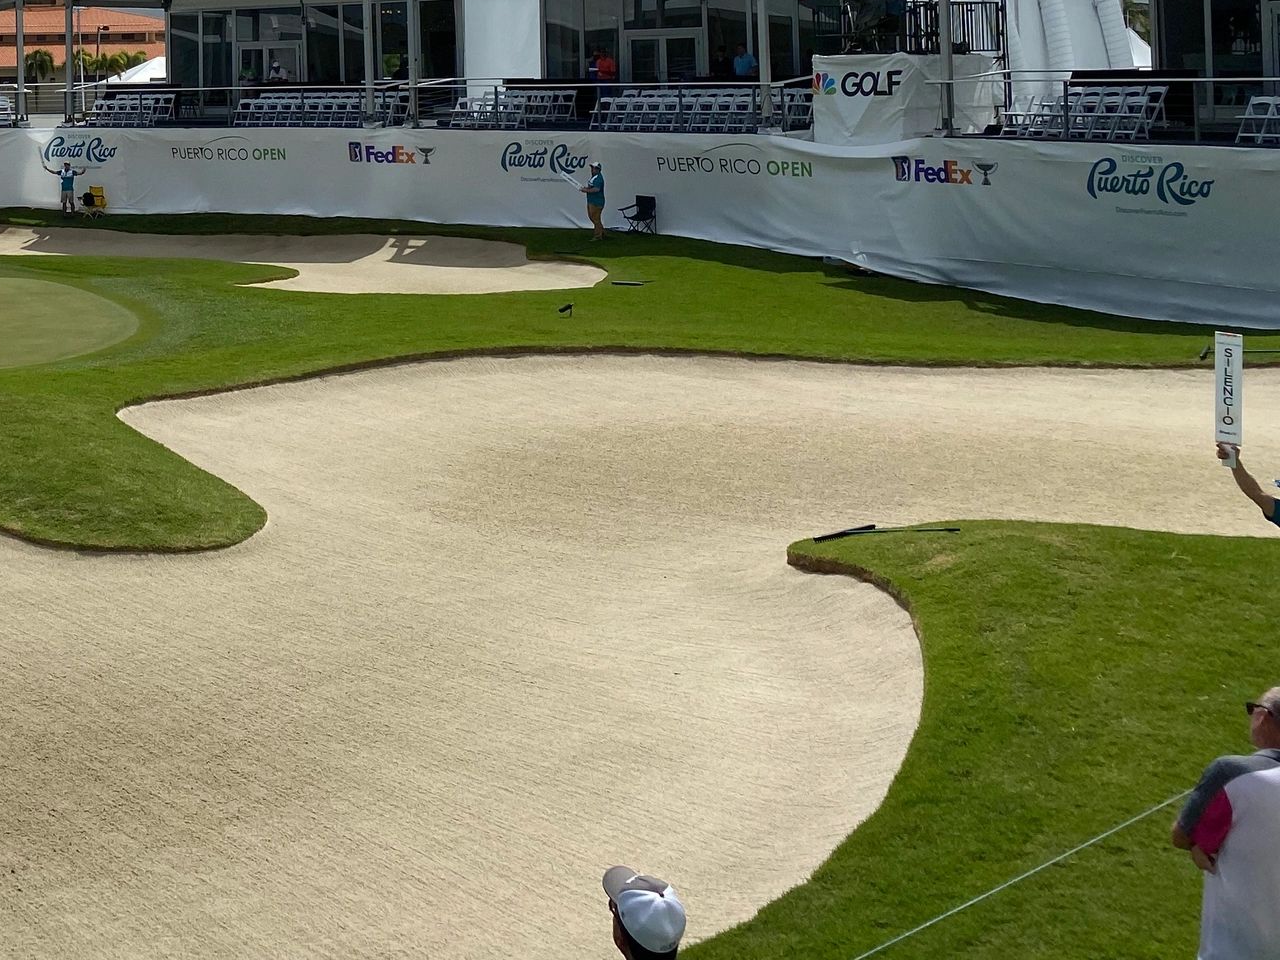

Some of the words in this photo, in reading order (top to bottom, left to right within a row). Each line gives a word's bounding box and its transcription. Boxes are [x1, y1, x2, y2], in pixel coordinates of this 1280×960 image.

[841, 70, 903, 97] GOLF
[44, 136, 86, 162] Puerto
[86, 137, 118, 162] Rico
[171, 147, 214, 160] PUERTO
[217, 148, 249, 160] RICO
[252, 148, 286, 160] OPEN
[365, 145, 416, 164] FedEx
[501, 142, 548, 172] Puerto
[550, 144, 588, 174] Rico
[1121, 154, 1163, 164] DISCOVER
[656, 156, 714, 173] PUERTO
[719, 158, 761, 175] RICO
[766, 160, 813, 178] OPEN
[914, 159, 973, 184] FedEx
[1087, 157, 1154, 199] Puerto
[1156, 162, 1215, 205] Rico
[1222, 348, 1234, 426] SILENCIO
